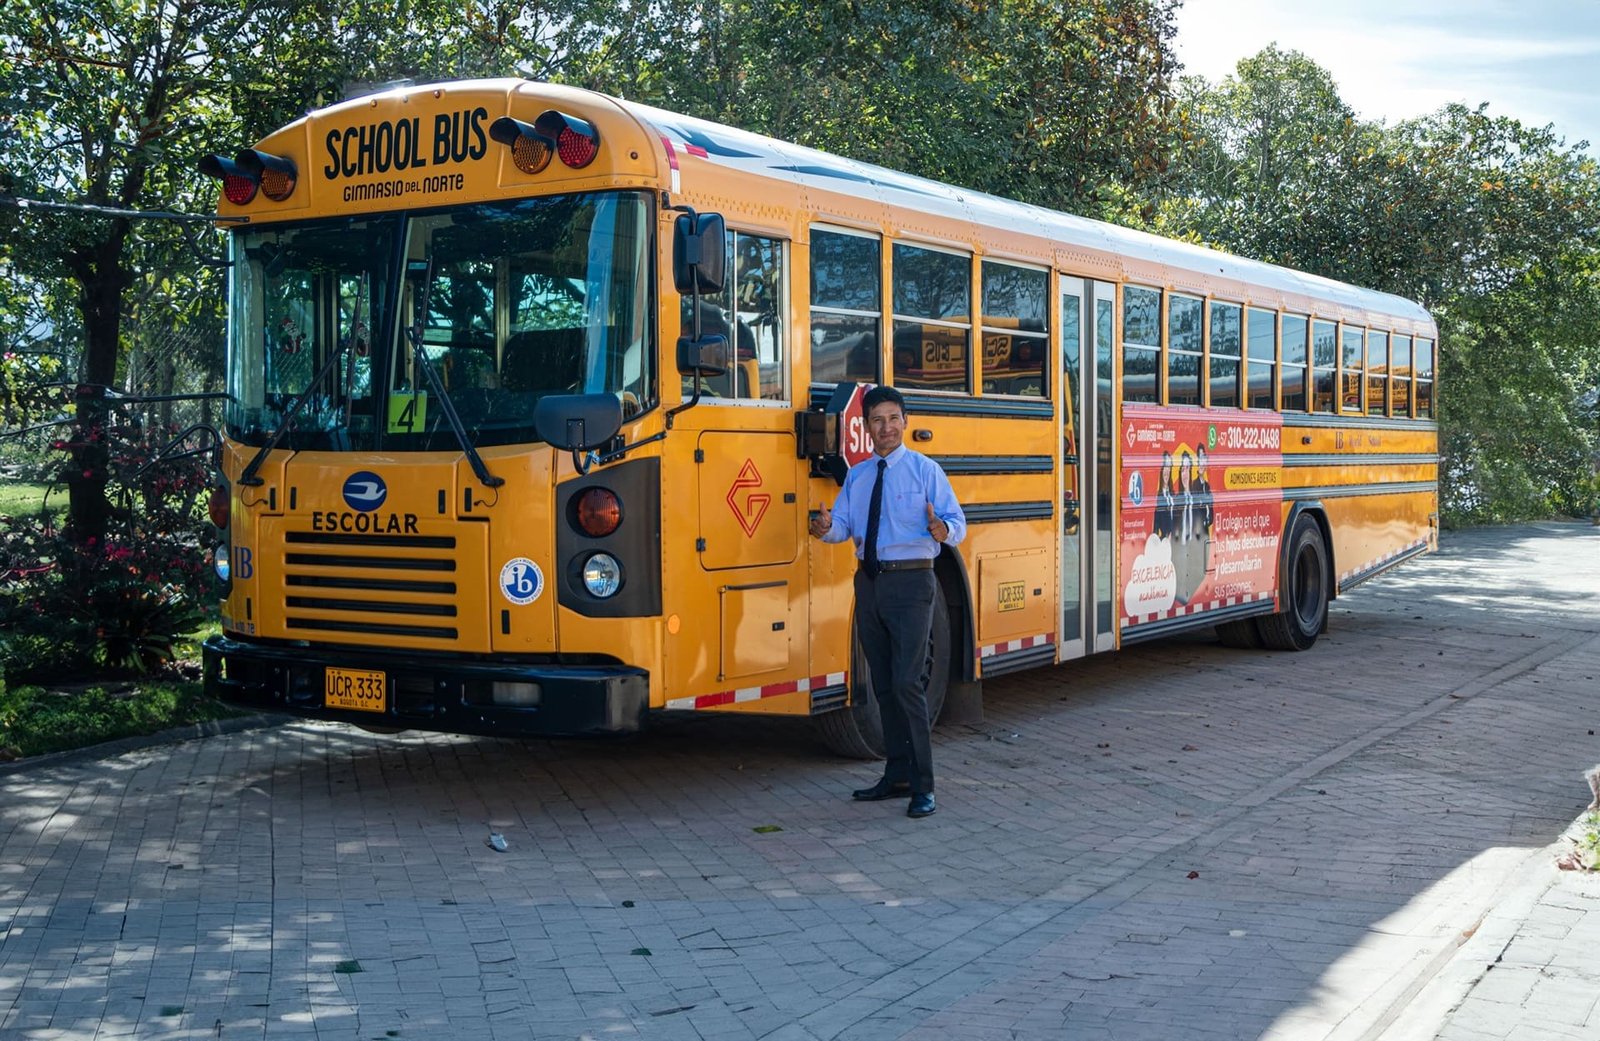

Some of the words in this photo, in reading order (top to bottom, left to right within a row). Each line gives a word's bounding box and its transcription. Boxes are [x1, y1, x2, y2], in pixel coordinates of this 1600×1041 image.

[324, 117, 427, 180] SCHOOL
[432, 107, 488, 165] BUS
[343, 180, 403, 202] GIMNASIO
[423, 174, 464, 194] NORTE
[397, 399, 415, 433] 4
[1229, 472, 1257, 485] ADMISIONES
[1256, 471, 1277, 484] ABIERTAS
[312, 511, 420, 534] ESCOLAR
[1222, 511, 1244, 534] colegio
[1244, 516, 1252, 529] en
[1252, 509, 1259, 528] el
[1259, 514, 1271, 530] que
[1225, 534, 1241, 556] hijos
[234, 545, 254, 579] IB
[1132, 564, 1174, 584] EXCELENCIA
